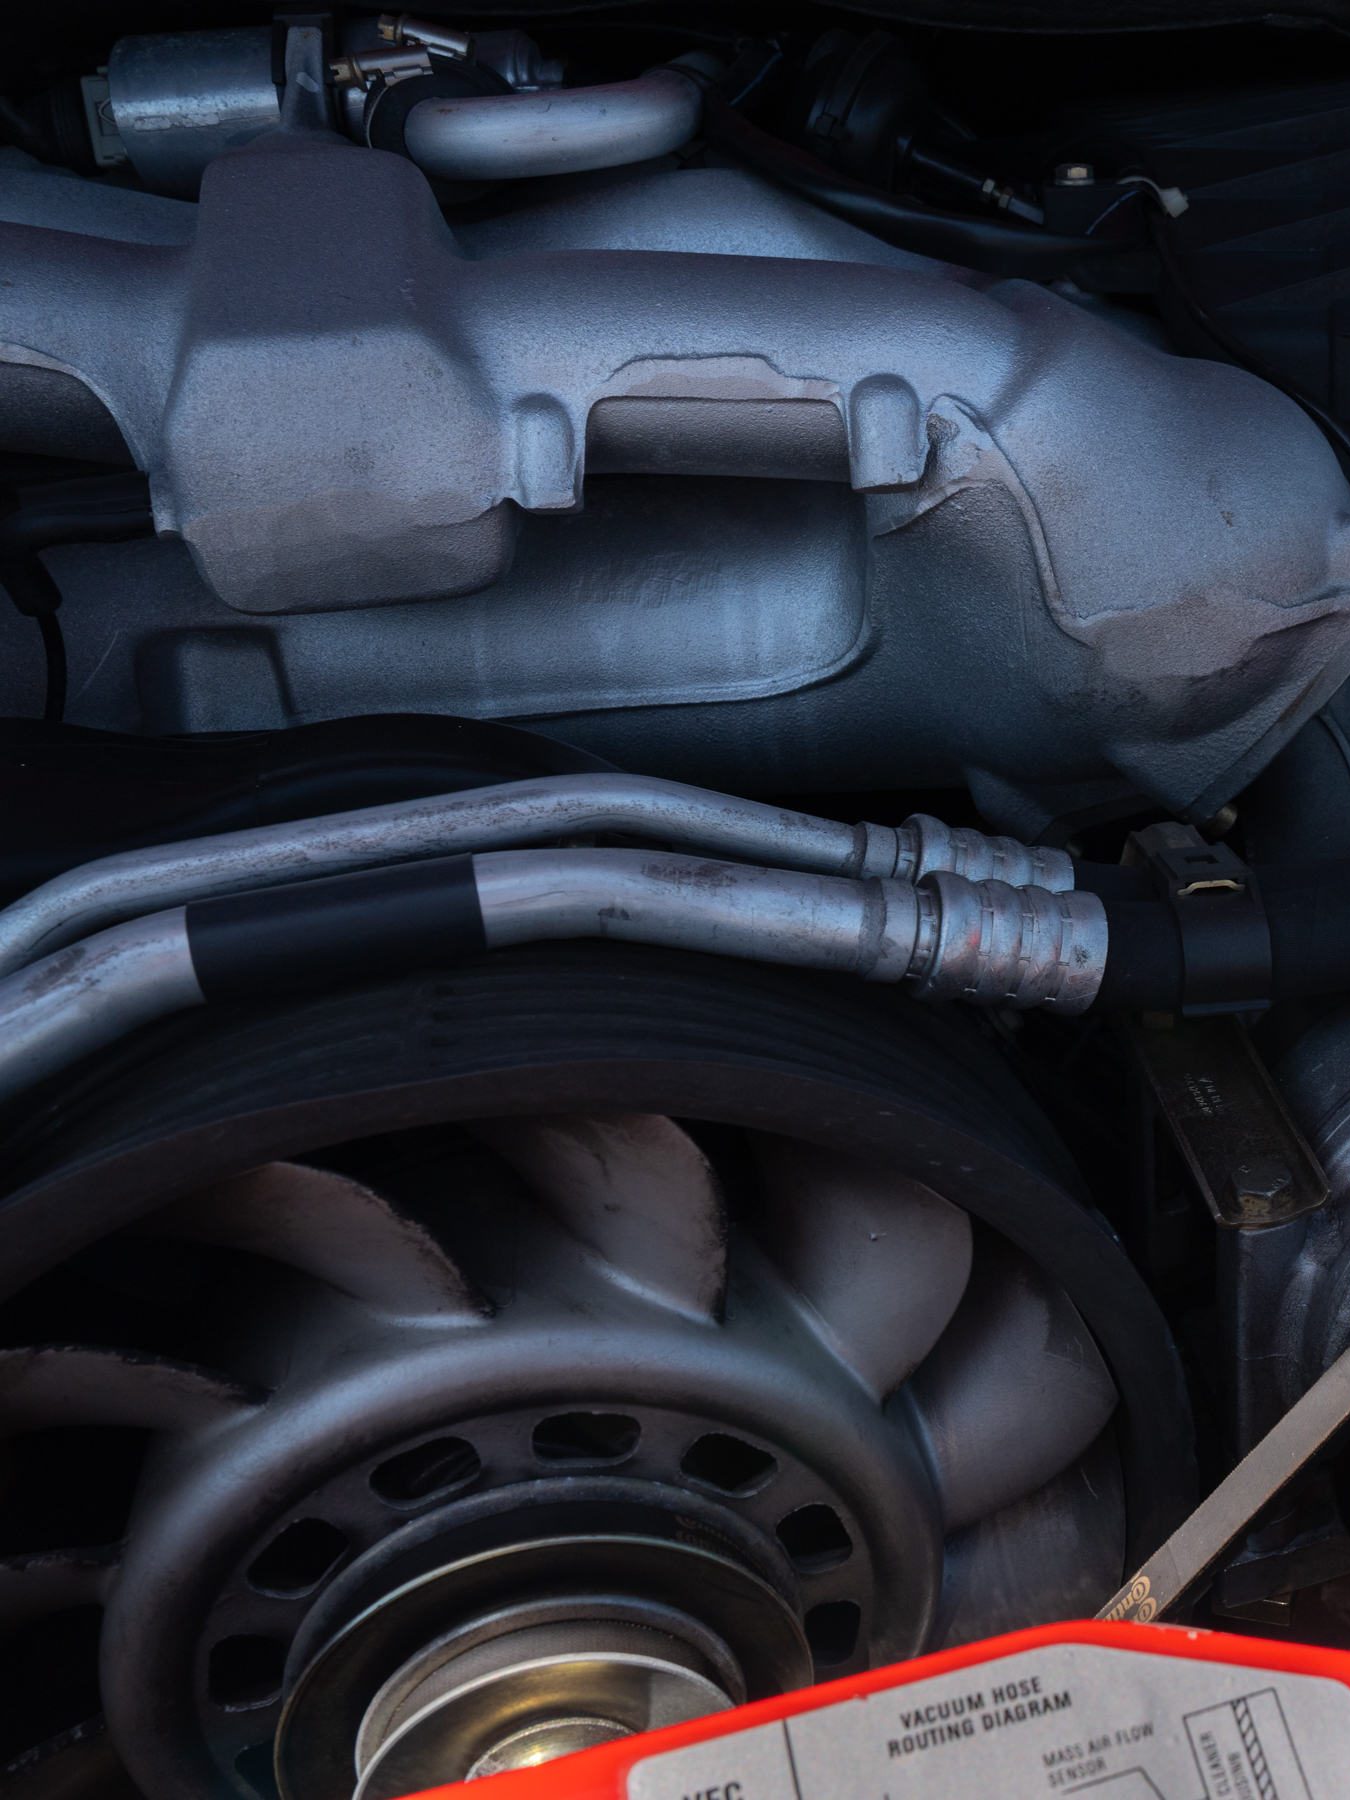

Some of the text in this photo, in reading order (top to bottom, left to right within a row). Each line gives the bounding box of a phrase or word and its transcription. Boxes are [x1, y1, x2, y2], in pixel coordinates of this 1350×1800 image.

[887, 1690, 1073, 1759] ROUTING DIAGRAM
[900, 1675, 1042, 1730] VACUUM HOSE
[1042, 1721, 1155, 1768] MASS AIR FLOW
[1199, 1730, 1231, 1797] CLEANER
[682, 1781, 745, 1800] EC
[1047, 1756, 1108, 1789] SENSOR
